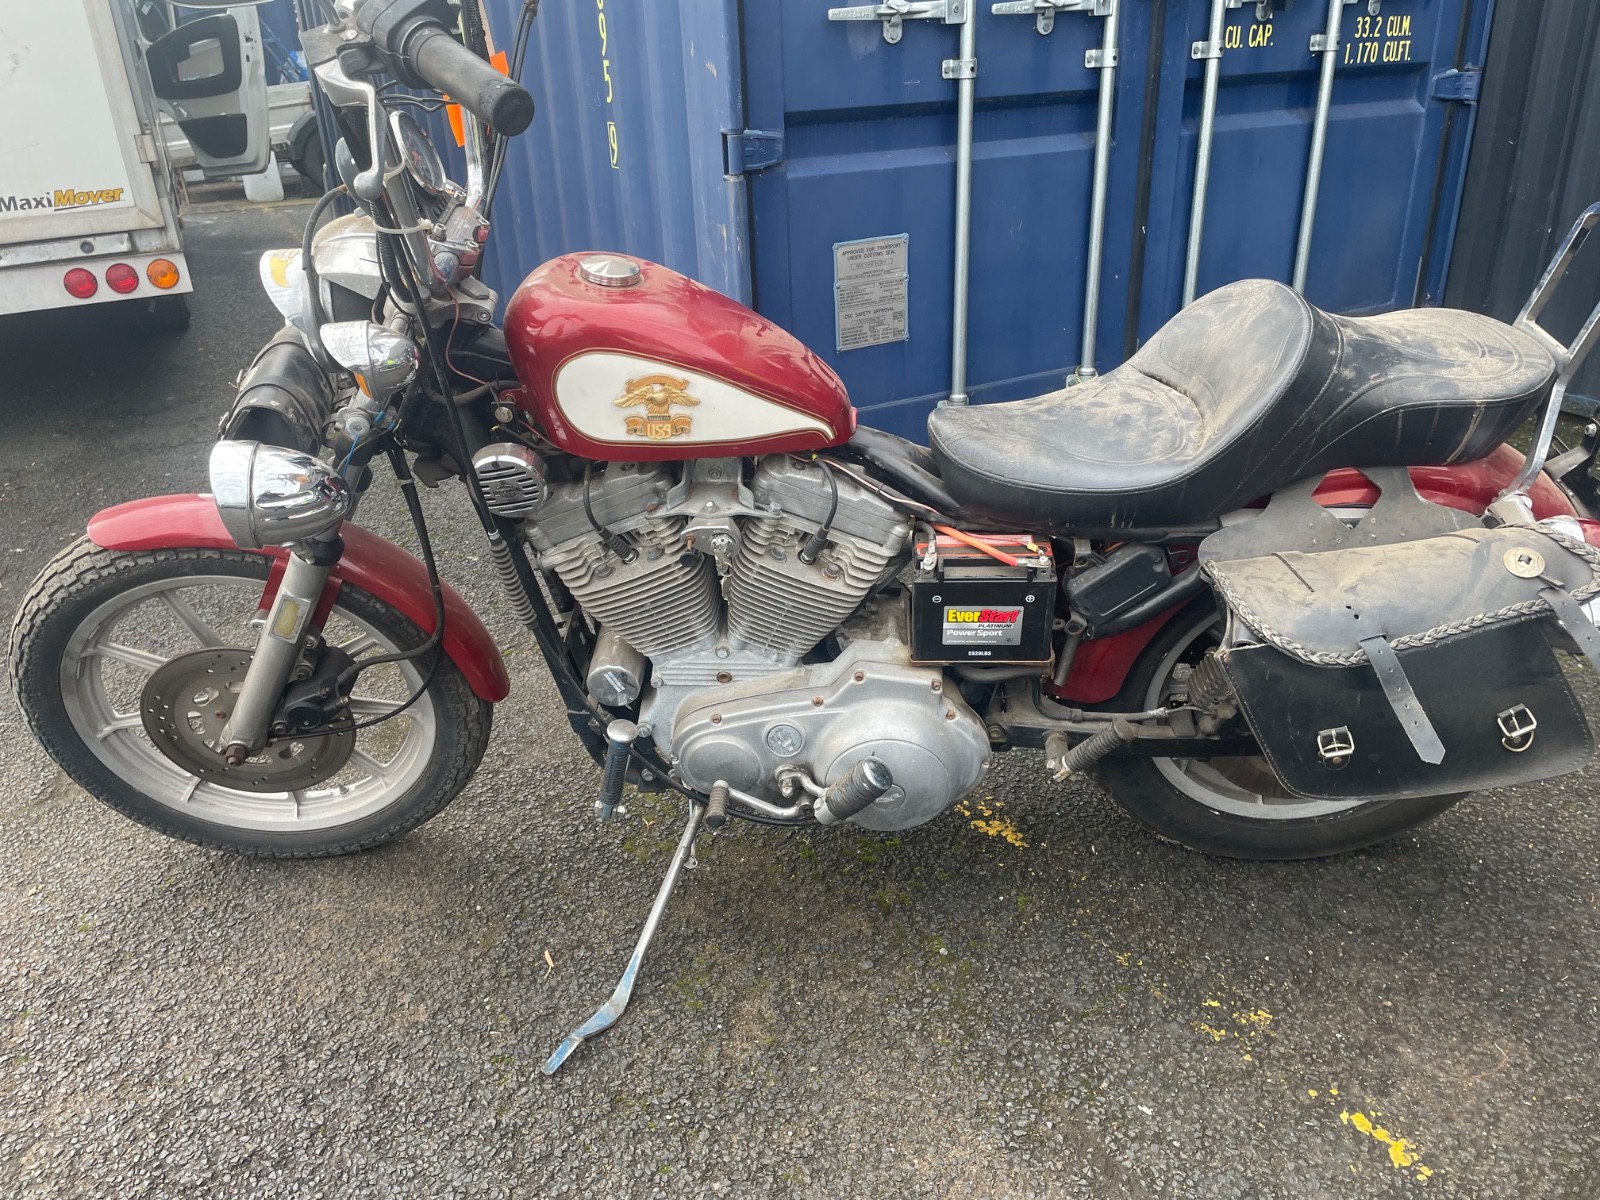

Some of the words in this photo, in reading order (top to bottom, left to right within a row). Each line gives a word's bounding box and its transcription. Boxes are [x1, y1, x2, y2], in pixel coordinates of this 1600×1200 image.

[1354, 16, 1383, 38] 33.2
[1225, 26, 1244, 49] CU.
[1248, 24, 1274, 48] CAP.
[863, 251, 884, 259] CUSTOMS
[855, 310, 871, 318] SAFETY
[647, 424, 671, 439] USA
[947, 609, 1019, 623] EverStart
